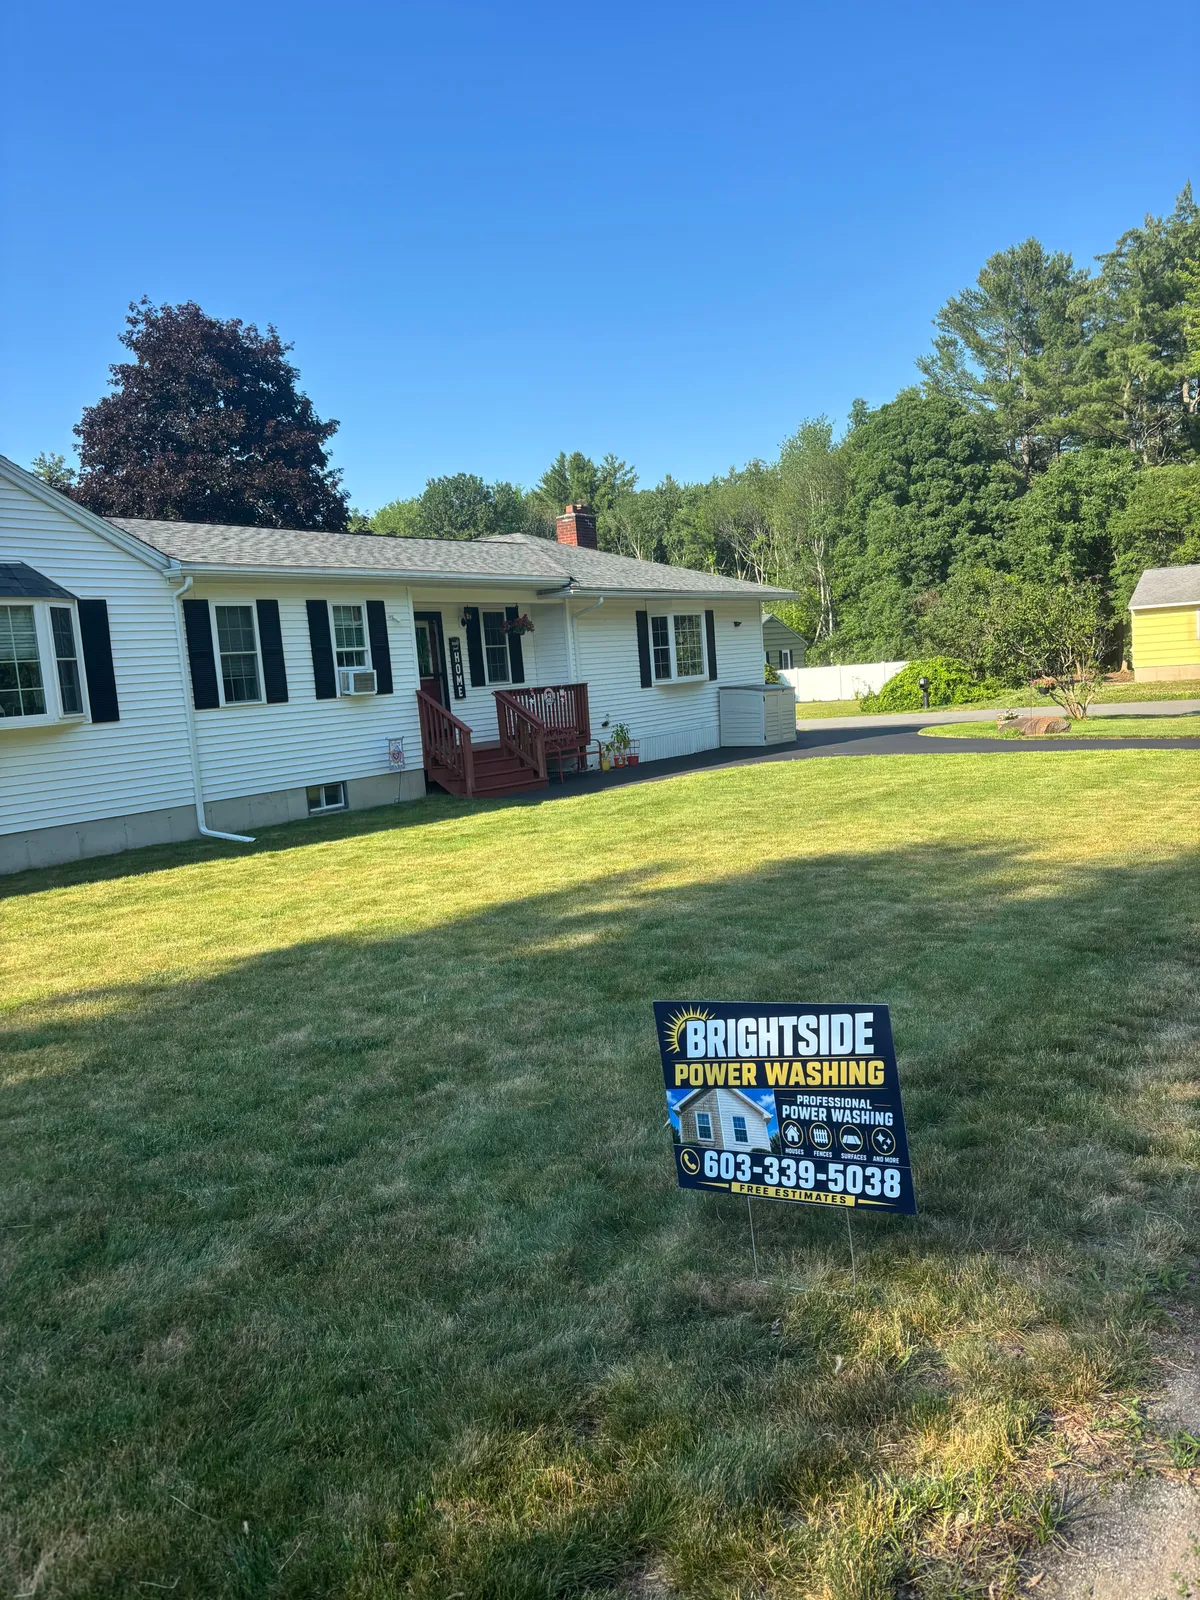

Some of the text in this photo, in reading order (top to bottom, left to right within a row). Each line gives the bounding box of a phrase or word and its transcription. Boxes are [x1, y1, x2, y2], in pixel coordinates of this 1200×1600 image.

[453, 651, 464, 697] HOME
[686, 1012, 874, 1058] BRIGHTSIDE
[674, 1060, 885, 1086] POWER WASHING
[796, 1094, 873, 1109] PROFESSIONAL
[782, 1105, 893, 1126] POWER WASHING
[785, 1147, 805, 1155] HOUSES
[813, 1150, 833, 1158] FENCES
[840, 1152, 867, 1161] SURFACES
[872, 1155, 884, 1163] AND
[704, 1150, 901, 1198] 603-339-5038
[739, 1184, 847, 1204] FREE ESTIMATES
